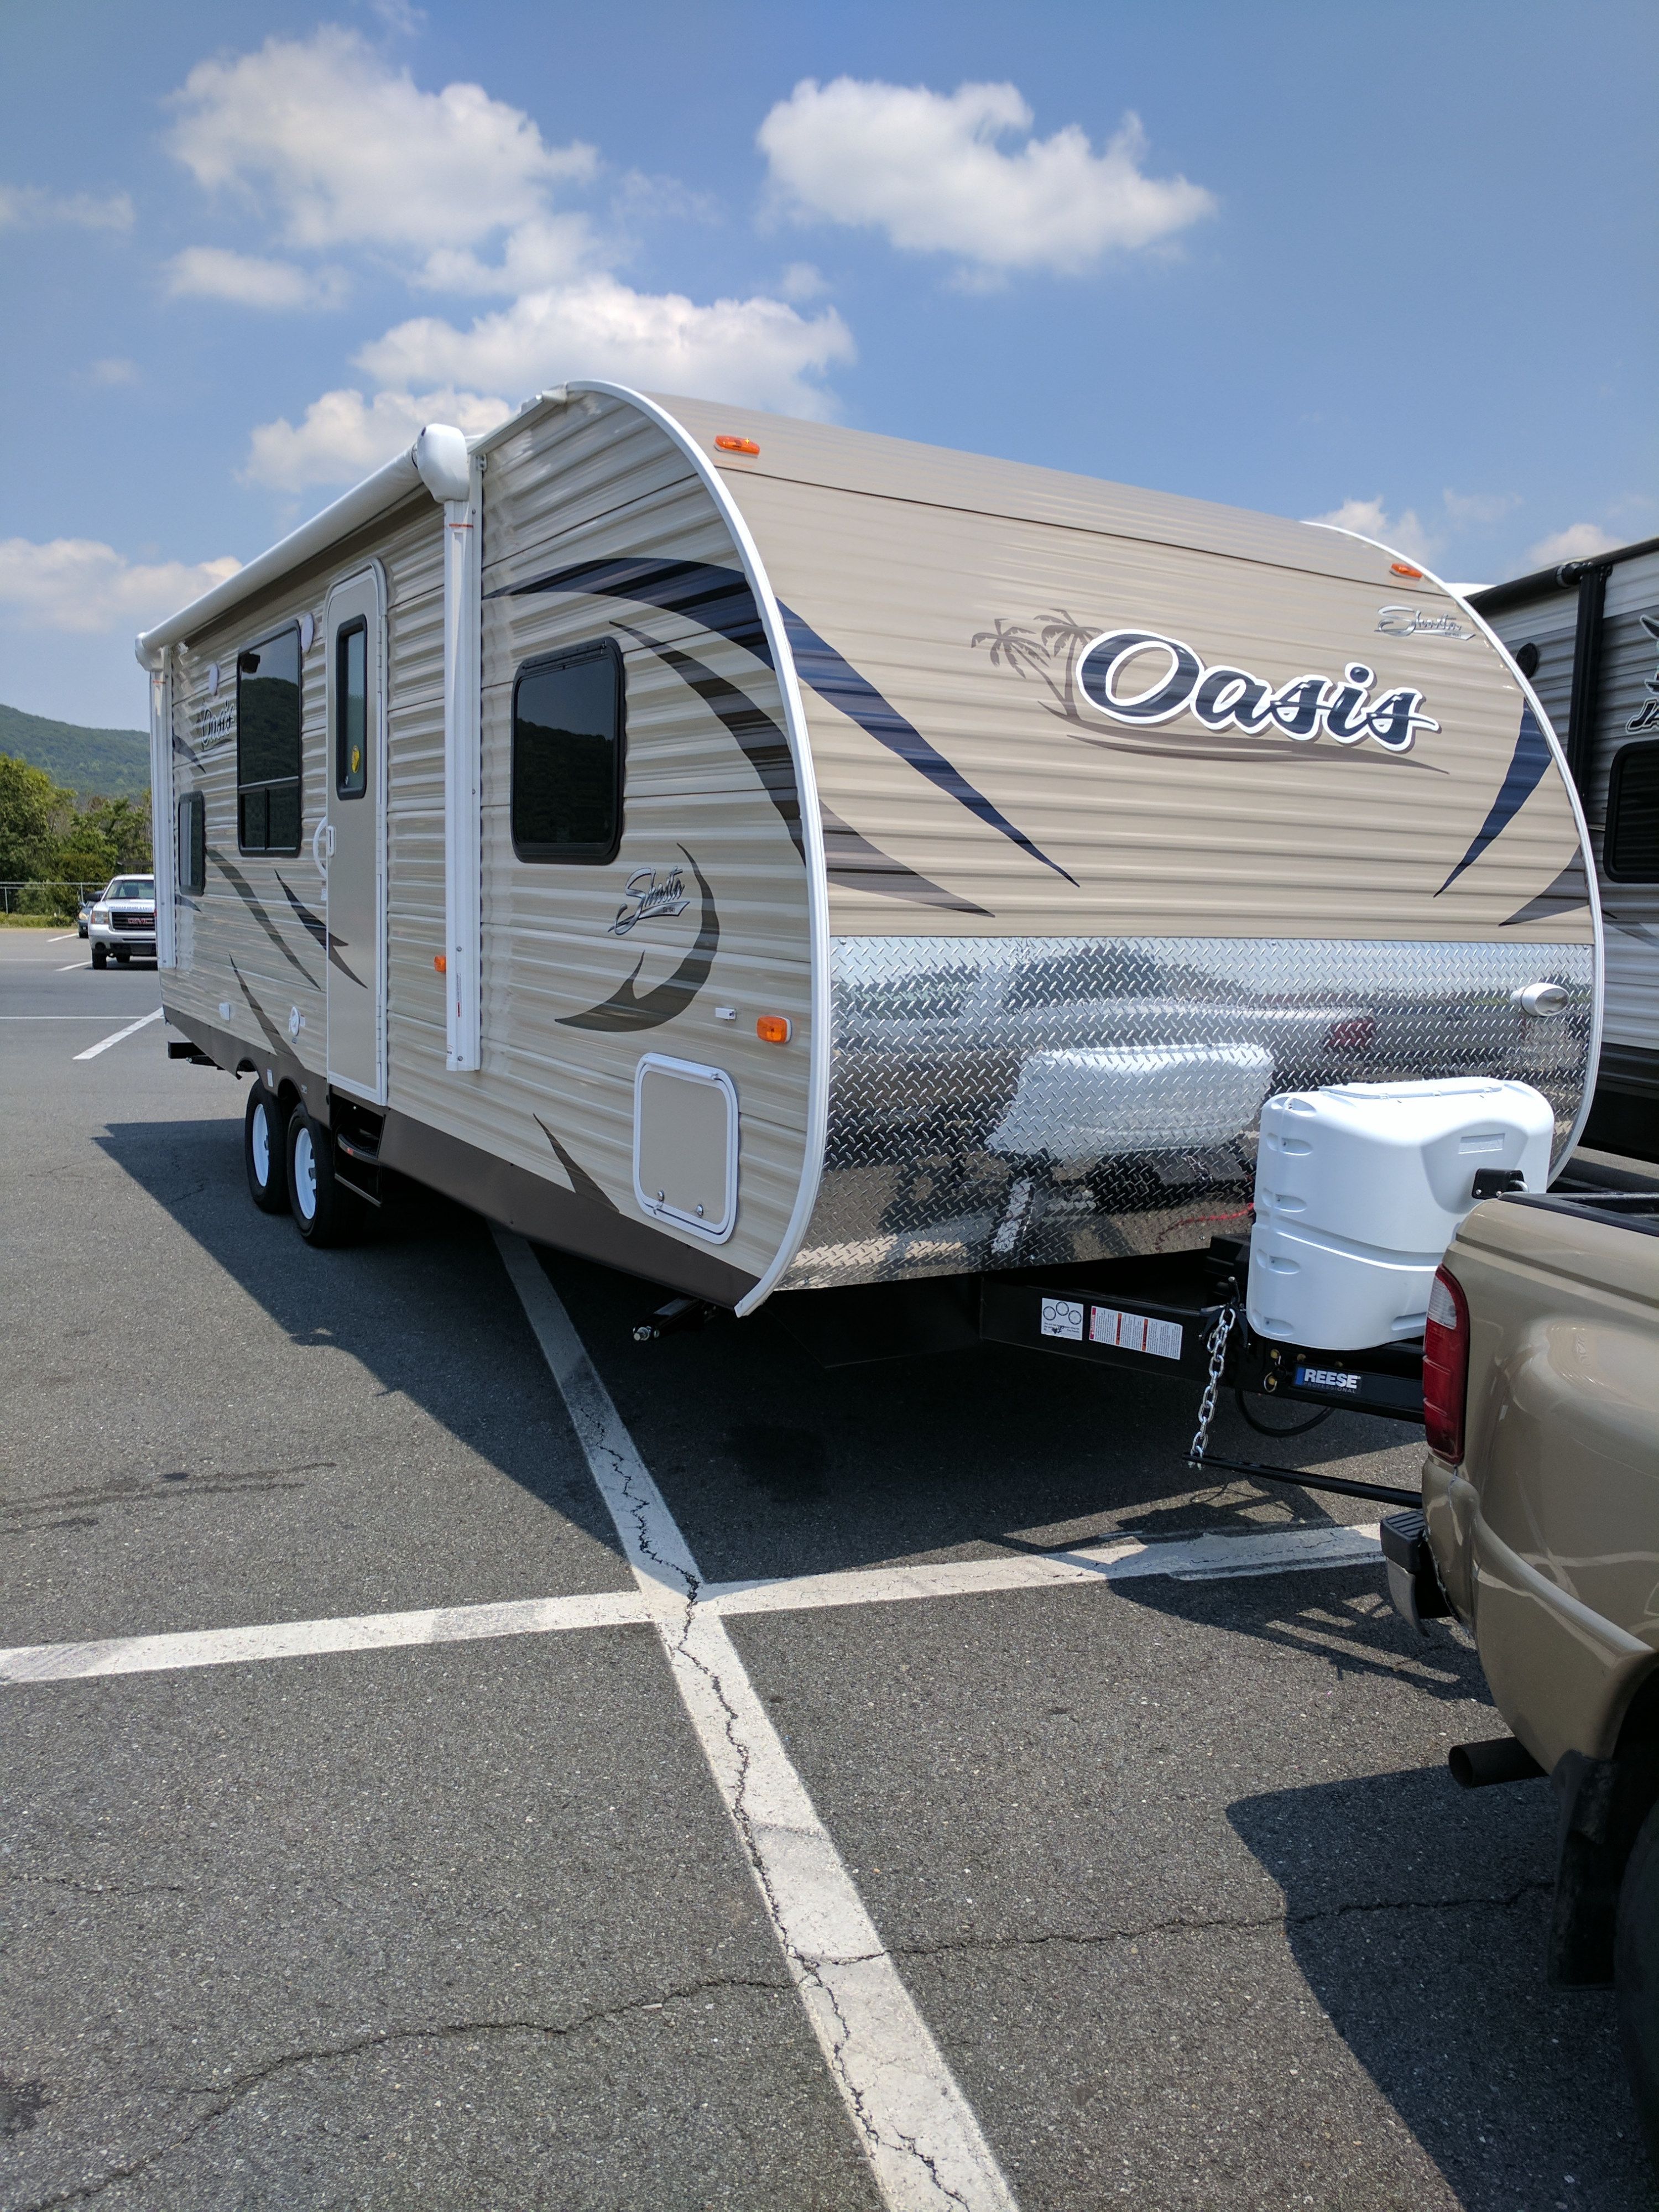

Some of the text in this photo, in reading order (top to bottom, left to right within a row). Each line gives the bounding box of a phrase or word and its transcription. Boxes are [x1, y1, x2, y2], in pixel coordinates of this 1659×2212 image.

[1374, 606, 1462, 637] Shasta
[1076, 629, 1441, 752] Oasis
[202, 698, 234, 746] Oasis
[613, 865, 685, 935] Shasta
[1302, 1381, 1356, 1394] PROFESSIONAL
[1304, 1368, 1358, 1389] REESE
